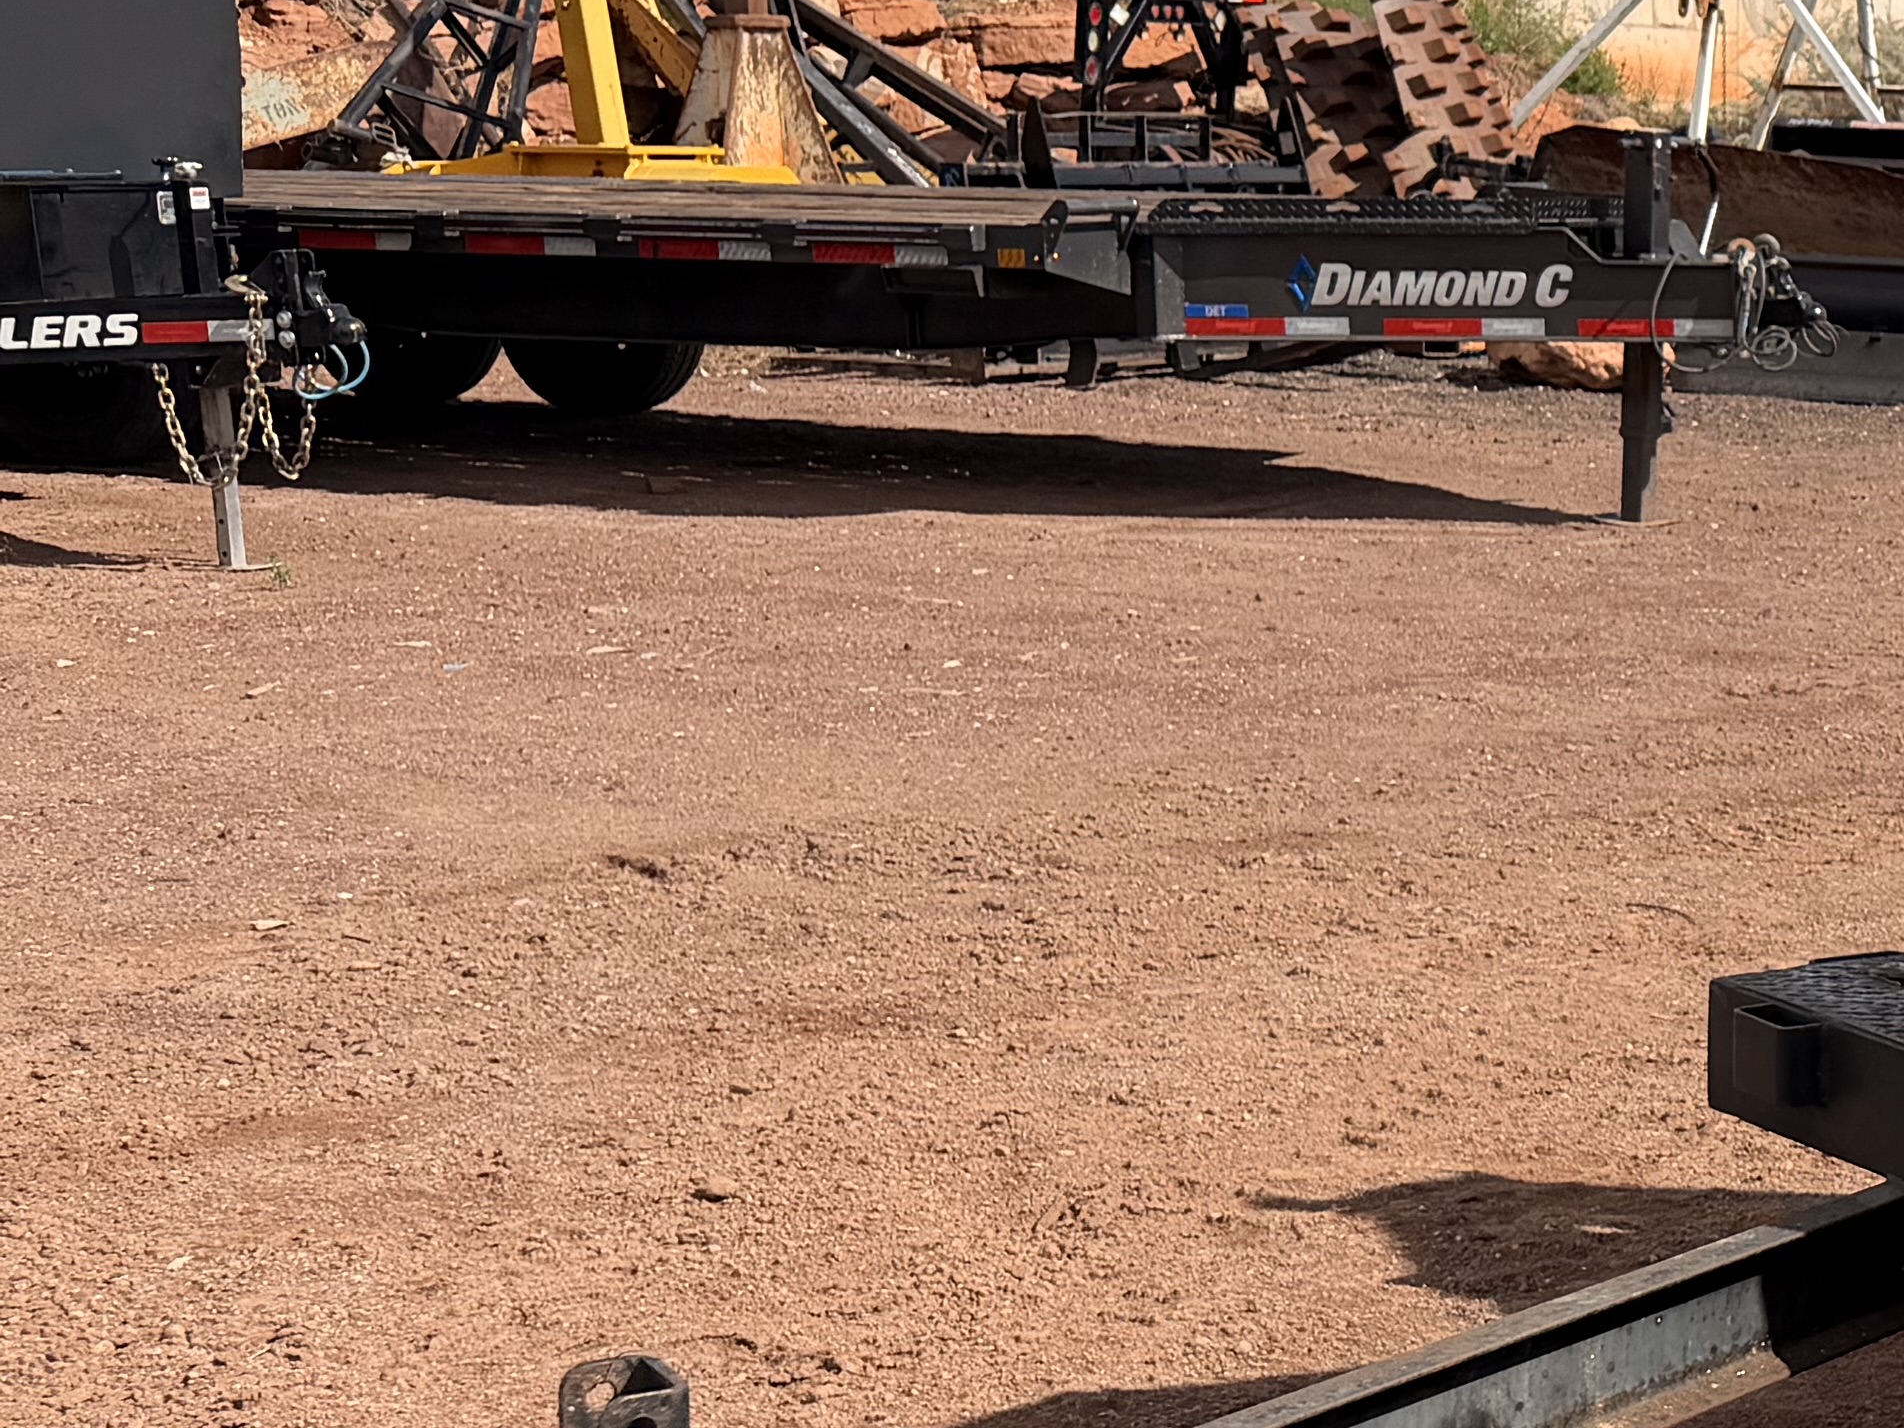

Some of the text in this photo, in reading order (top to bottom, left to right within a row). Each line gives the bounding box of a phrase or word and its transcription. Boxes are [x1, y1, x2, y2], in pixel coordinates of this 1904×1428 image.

[1310, 262, 1573, 307] DIAMOND C
[0, 313, 139, 350] LERS
